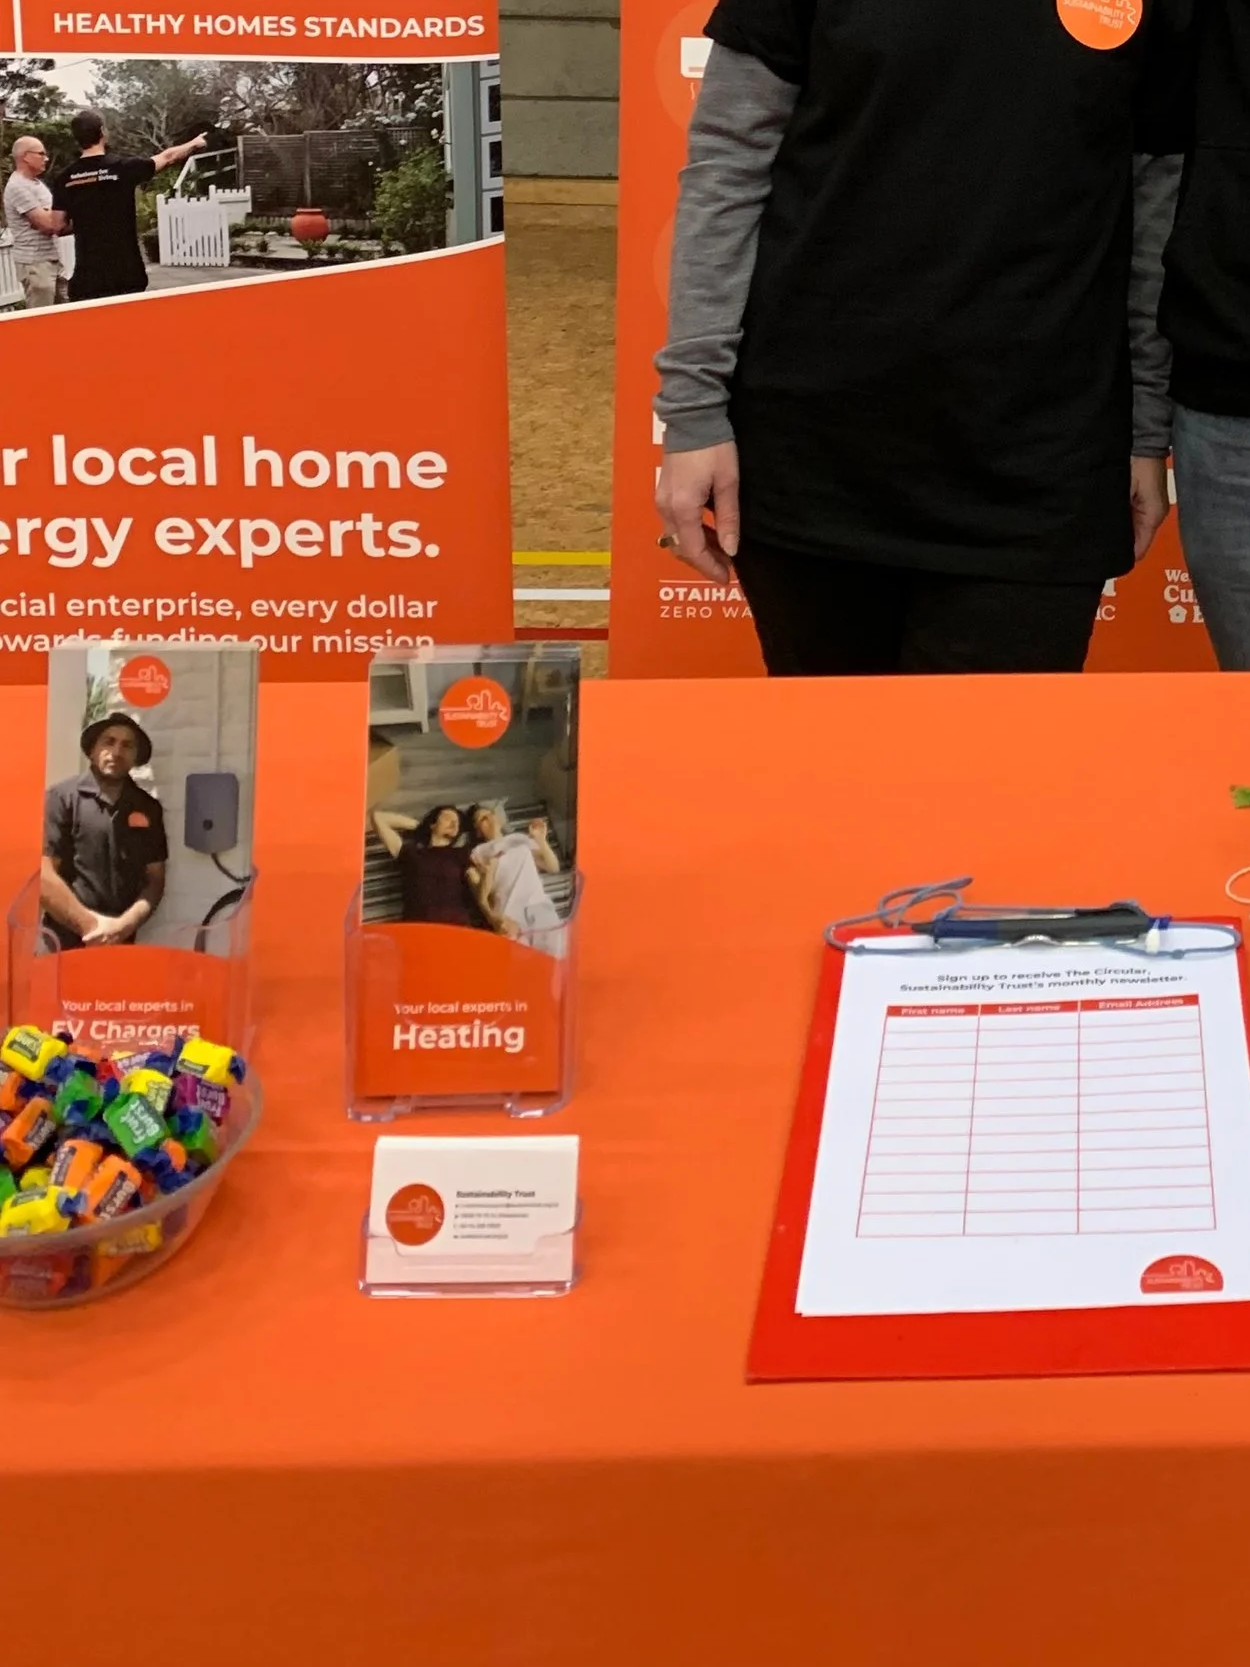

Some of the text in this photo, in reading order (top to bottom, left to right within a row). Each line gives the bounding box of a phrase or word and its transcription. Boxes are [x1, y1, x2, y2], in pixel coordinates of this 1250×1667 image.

[54, 12, 485, 39] HEALTHY HOMES STANDARDS
[52, 434, 218, 486] local
[243, 436, 447, 489] home
[0, 512, 441, 568] rgy experts.
[659, 587, 748, 602] OTAIHA
[66, 591, 242, 622] enterprise,
[250, 598, 338, 623] every
[346, 594, 438, 619] dollar
[659, 606, 713, 619] ZERO
[249, 634, 302, 653] our
[312, 628, 435, 653] mission
[900, 982, 995, 992] Sustainability
[1048, 977, 1106, 987] monthly
[937, 974, 967, 982] Sign
[972, 975, 990, 983] up
[1012, 971, 1061, 980] receive
[62, 998, 194, 1014] Your local experts in
[427, 1000, 460, 1014] local
[462, 1000, 512, 1015] experts
[515, 999, 528, 1013] in
[89, 1019, 201, 1041] Chargers
[393, 1018, 525, 1054] Heating
